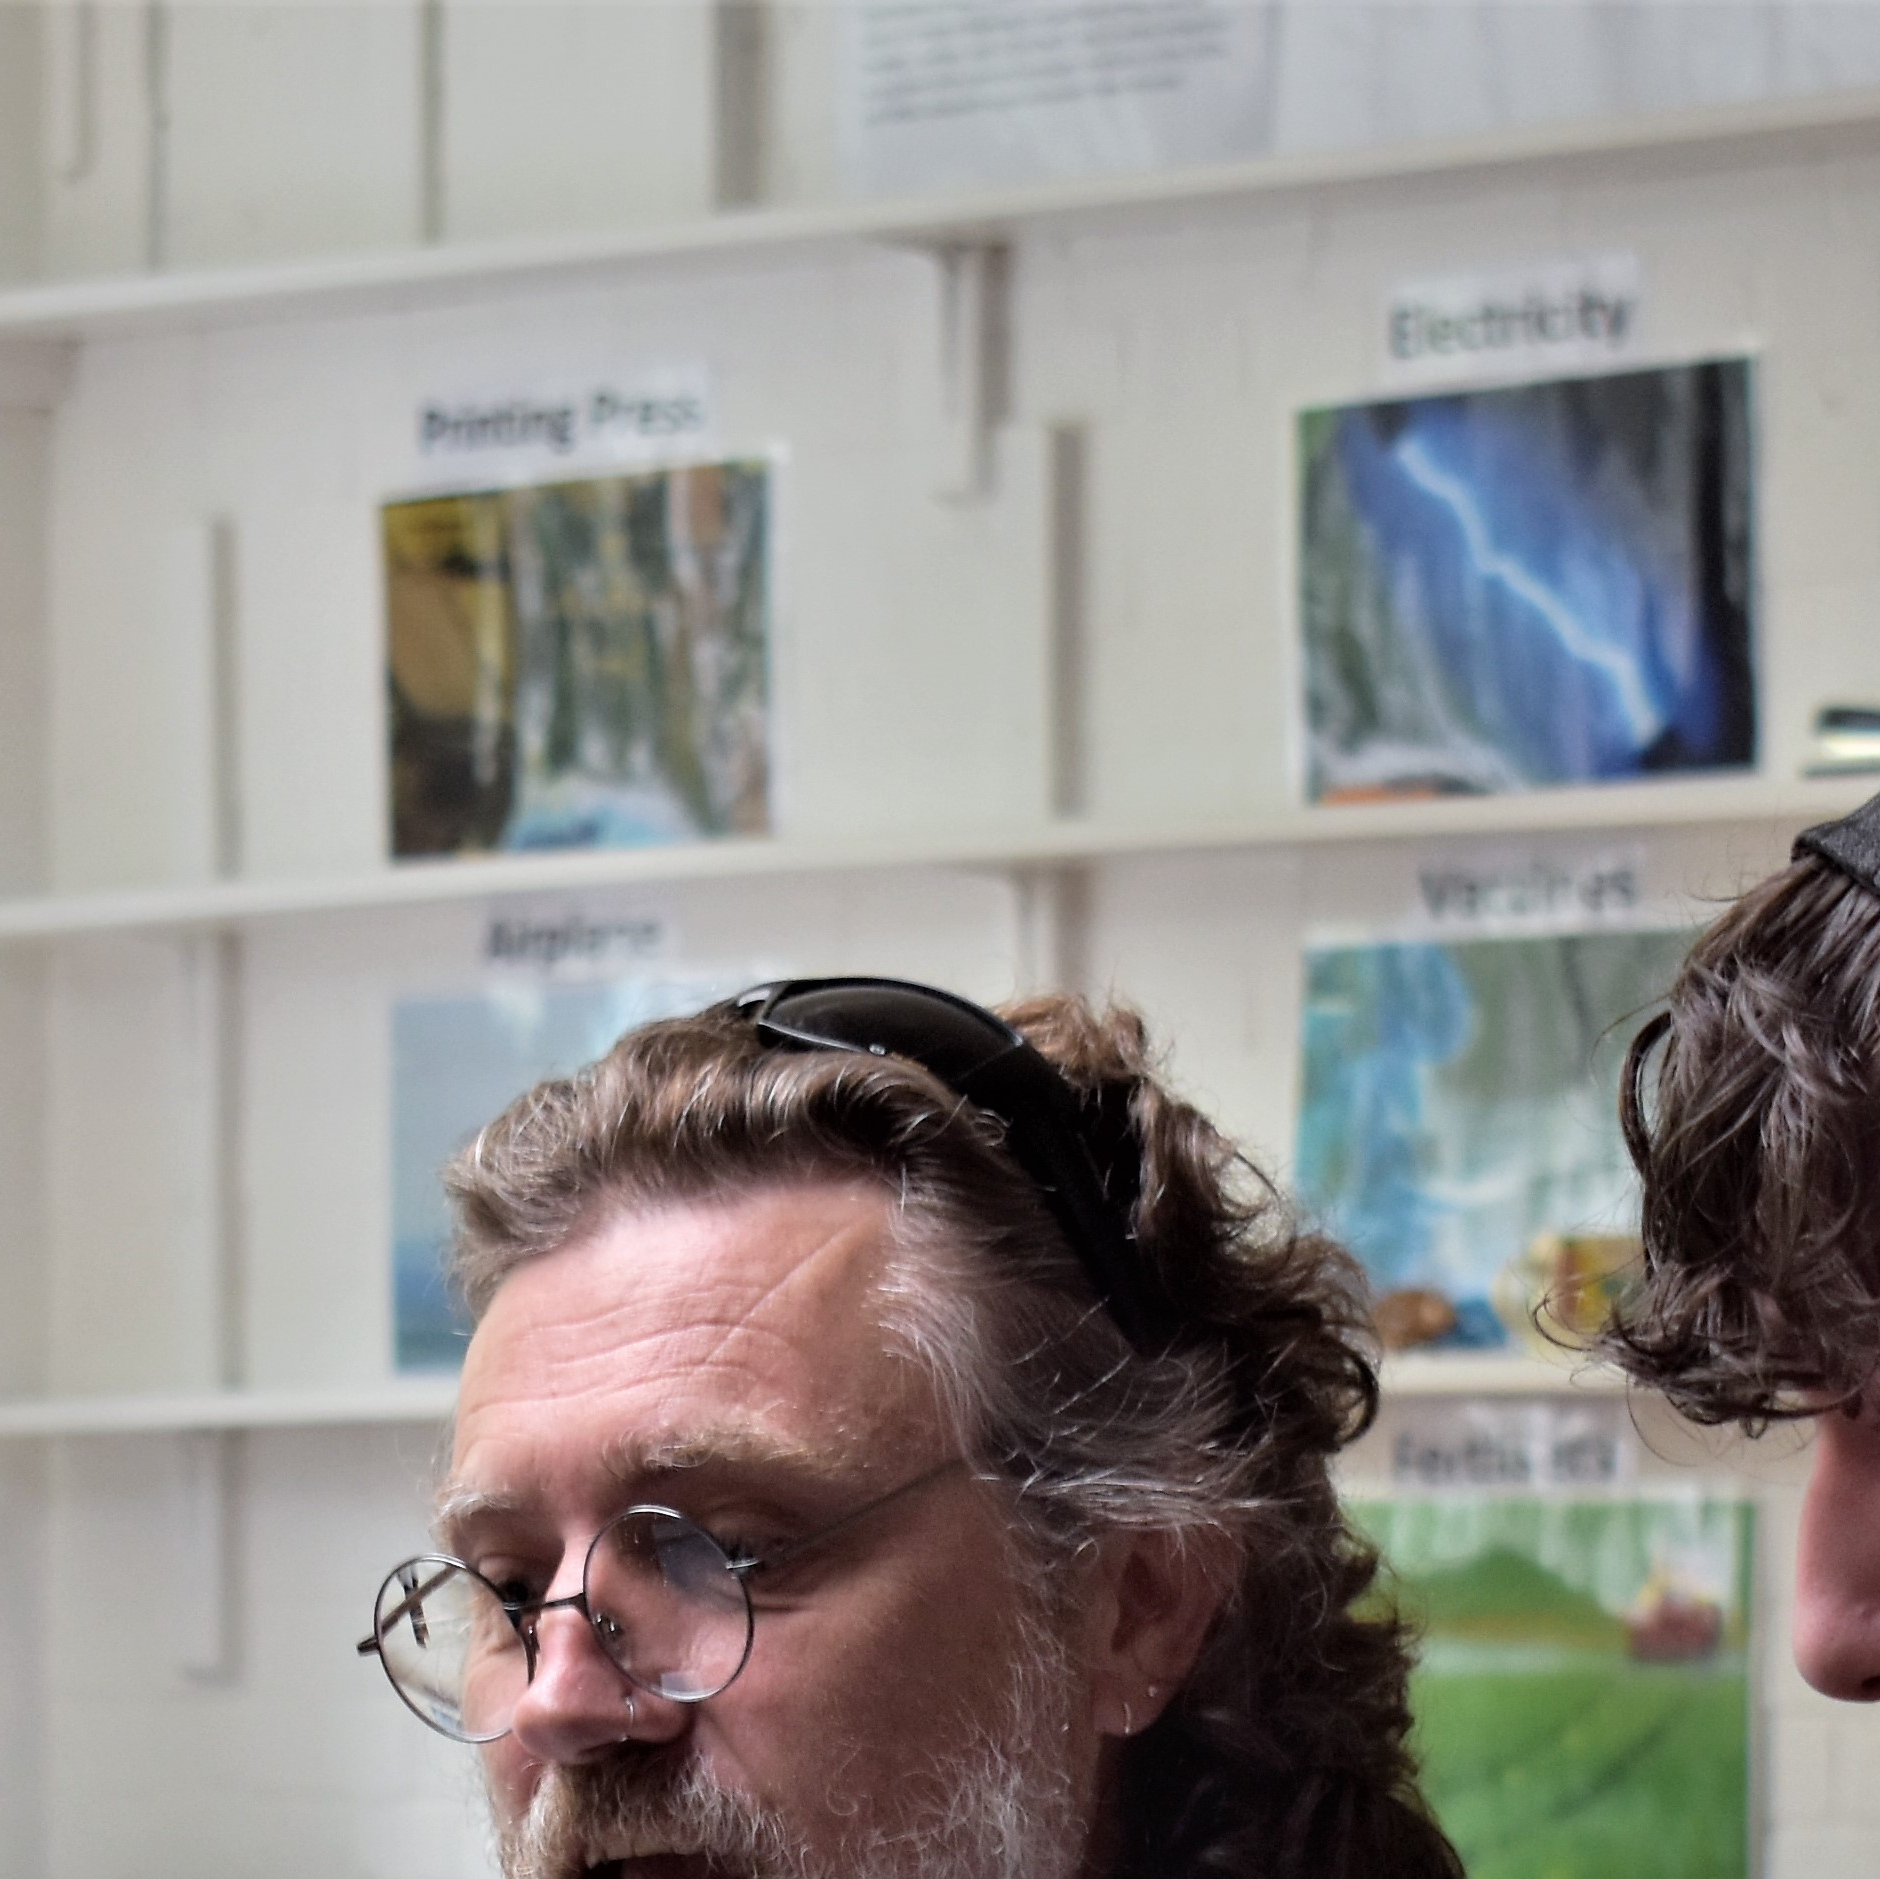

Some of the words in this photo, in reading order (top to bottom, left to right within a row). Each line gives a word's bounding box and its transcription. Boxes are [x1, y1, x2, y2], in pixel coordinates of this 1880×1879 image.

[1389, 287, 1629, 358] Electricity
[421, 402, 573, 455] Printing
[592, 387, 702, 434] Press
